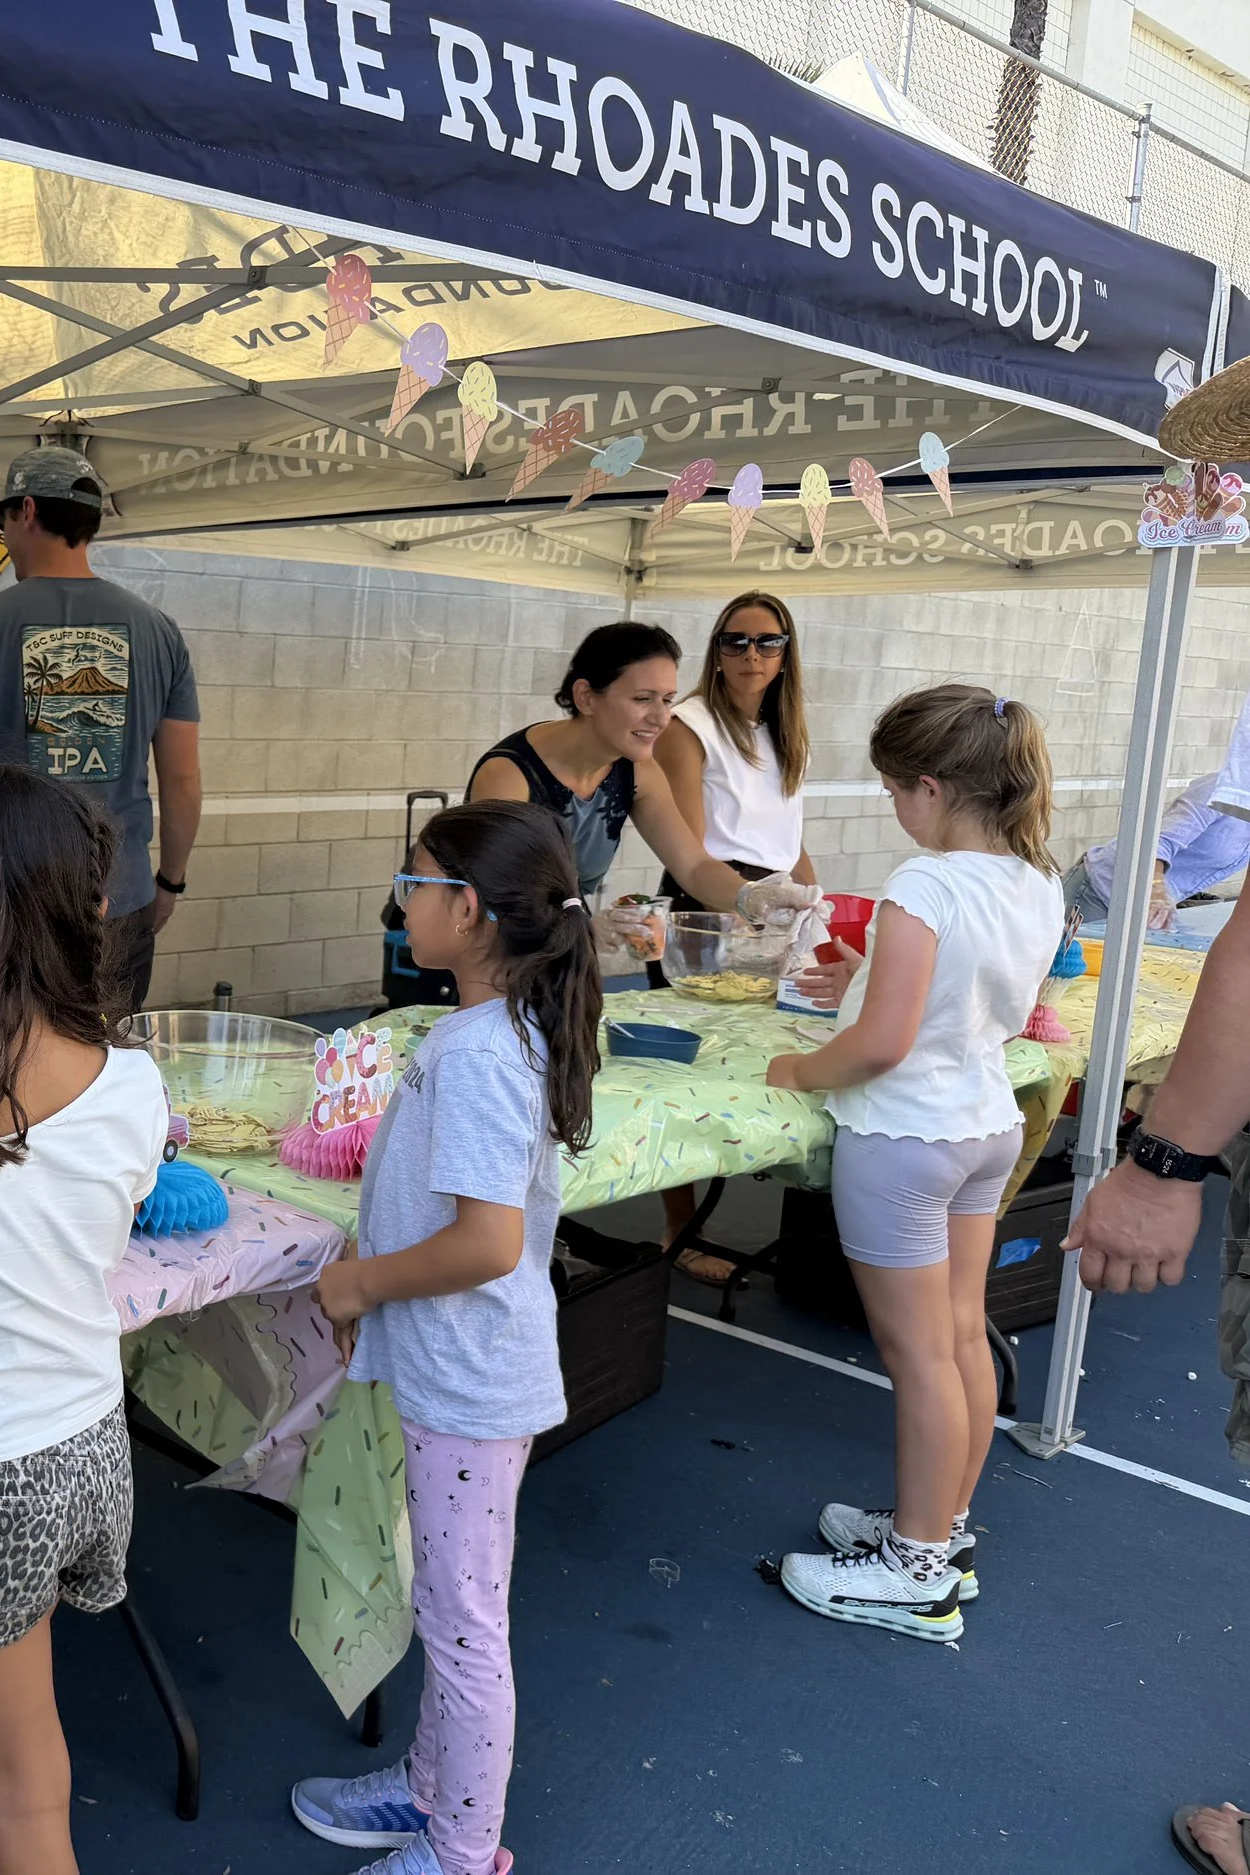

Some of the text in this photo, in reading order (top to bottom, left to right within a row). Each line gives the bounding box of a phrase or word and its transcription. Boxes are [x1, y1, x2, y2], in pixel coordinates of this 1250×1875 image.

[429, 17, 852, 259] RHOADES
[871, 182, 1090, 353] SCHOOL
[1146, 521, 1179, 541] Ice
[76, 631, 124, 653] DESIGNS
[47, 746, 108, 775] IPA
